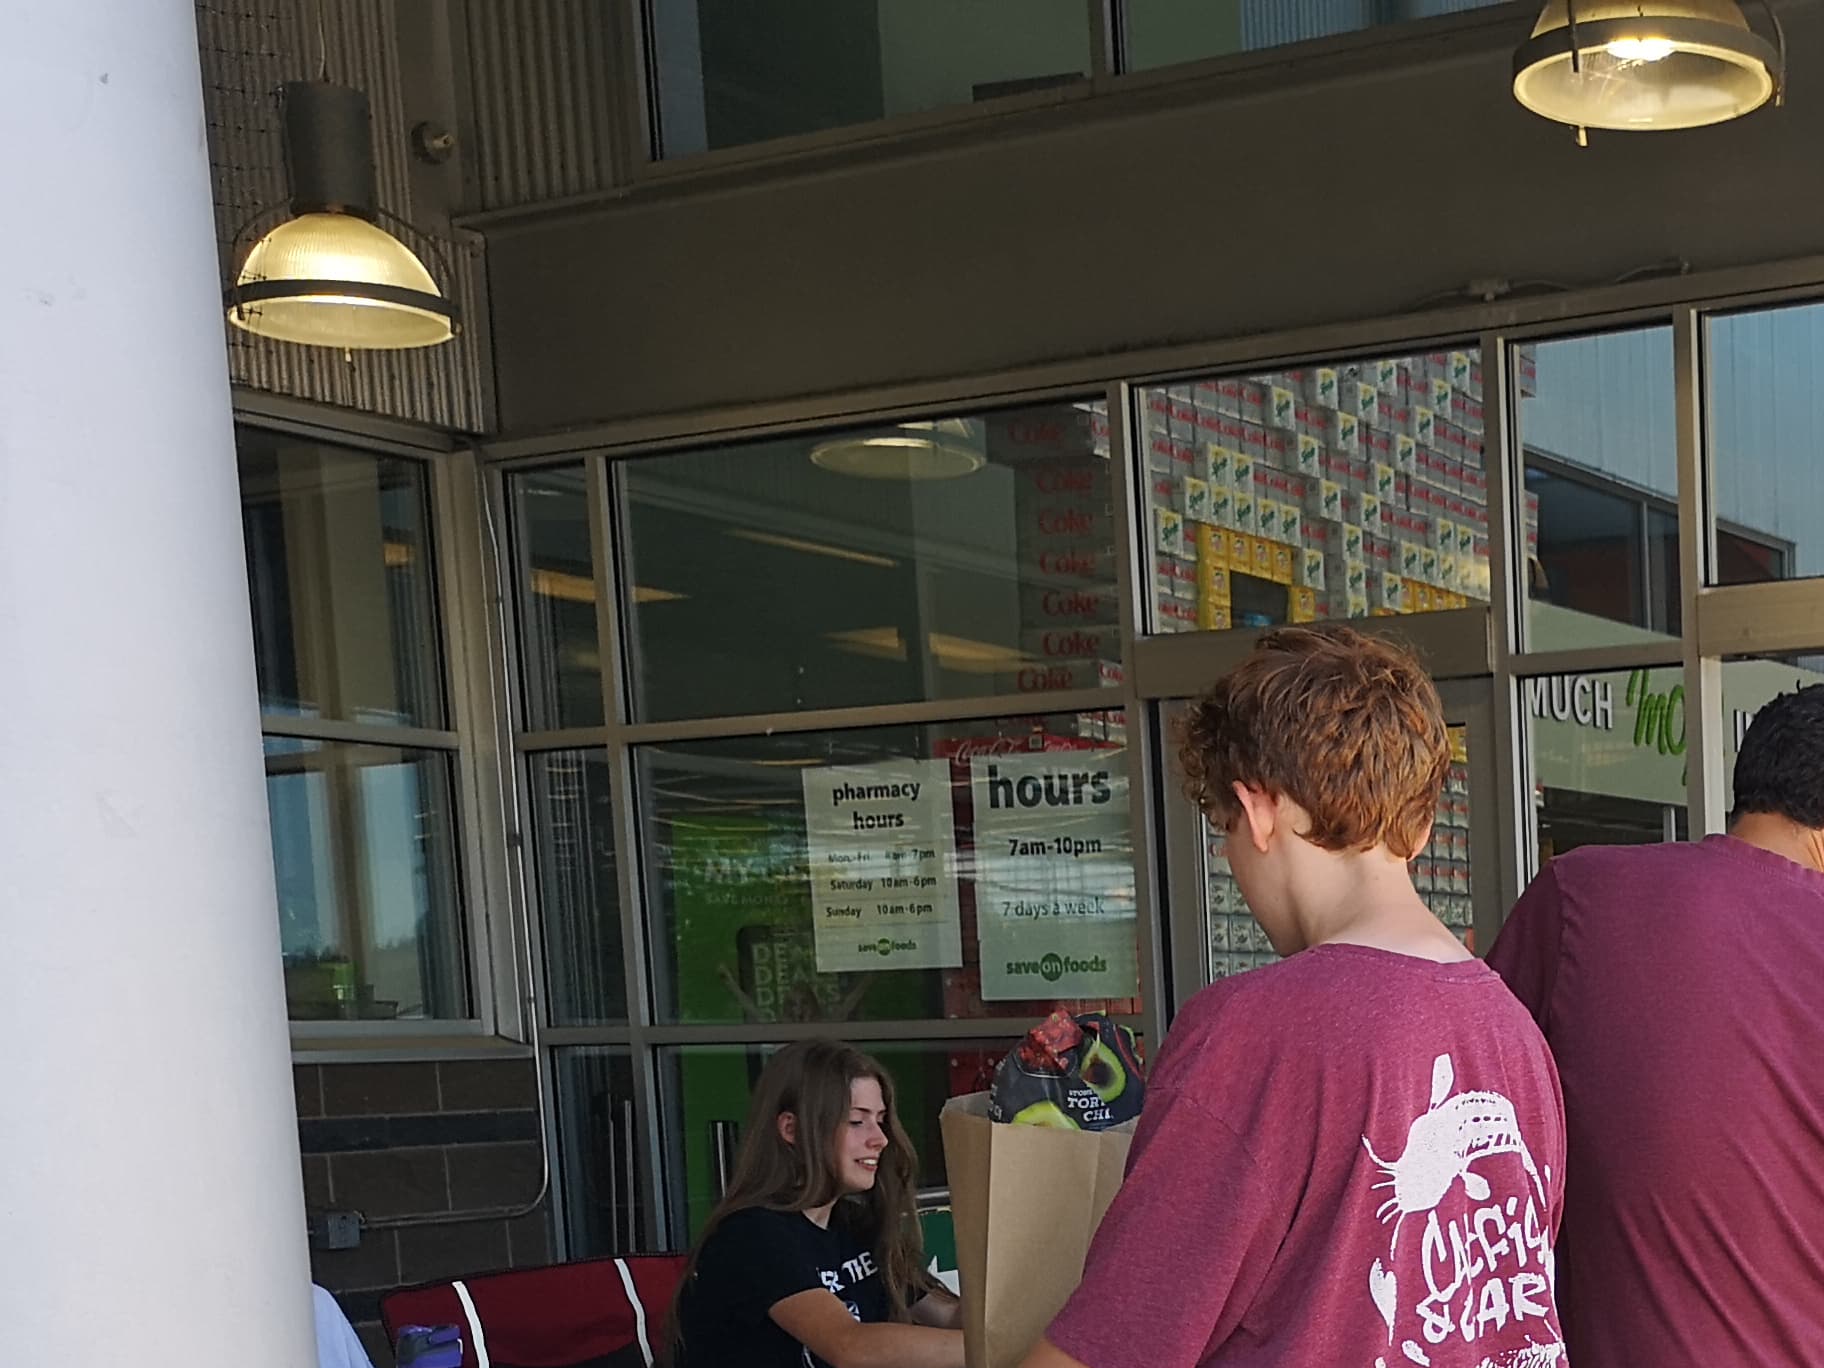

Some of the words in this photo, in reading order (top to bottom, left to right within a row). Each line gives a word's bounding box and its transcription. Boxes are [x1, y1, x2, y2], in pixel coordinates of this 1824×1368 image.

[1043, 590, 1100, 617] Coke
[1043, 630, 1100, 657] Coke
[1017, 666, 1073, 692] Coke
[1531, 675, 1613, 730] MUCH
[832, 782, 921, 806] pharmacy
[987, 764, 1112, 809] hours
[852, 810, 905, 830] hours
[1008, 836, 1103, 858] 7am-10pm
[830, 879, 873, 892] Saturday
[826, 907, 862, 919] Sunday
[1002, 901, 1012, 916] 7
[1014, 900, 1049, 920] days
[1052, 902, 1061, 914] a
[1063, 896, 1105, 914] week
[841, 1251, 878, 1284] THE
